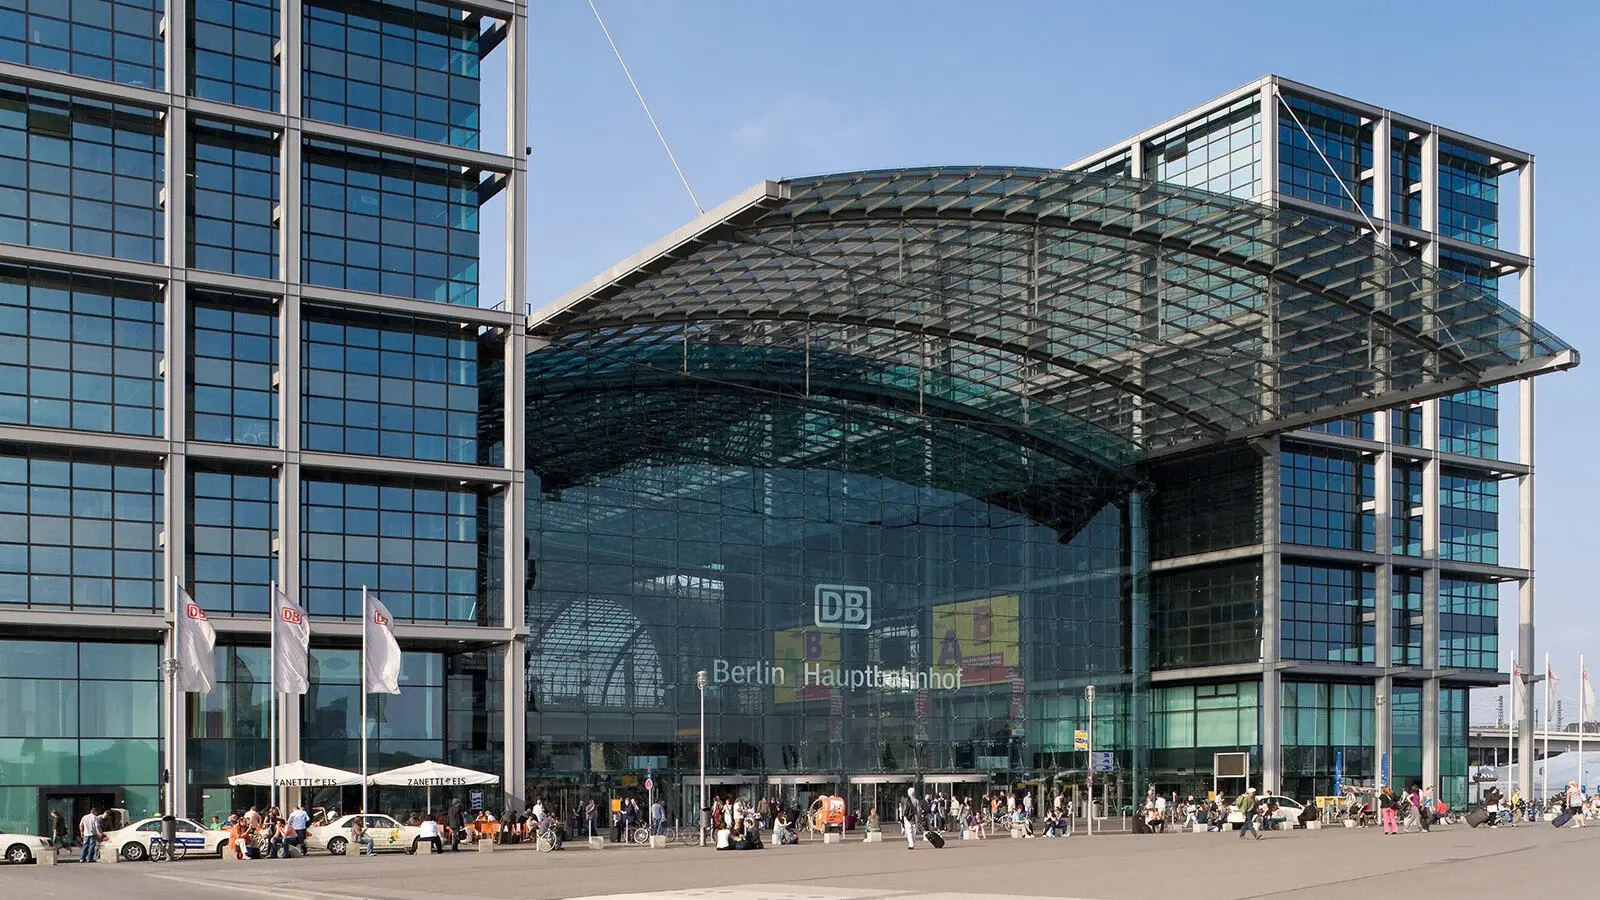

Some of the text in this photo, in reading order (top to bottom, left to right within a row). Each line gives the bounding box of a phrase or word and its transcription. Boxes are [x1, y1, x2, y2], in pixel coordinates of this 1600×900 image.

[284, 609, 301, 622] DB
[821, 590, 865, 623] DB
[805, 631, 822, 659] B
[938, 629, 961, 668] A
[713, 658, 785, 685] Berlin
[804, 662, 963, 692] Hauptbahnhof
[322, 778, 337, 786] EIS
[407, 777, 467, 786] ZANETTI EIS
